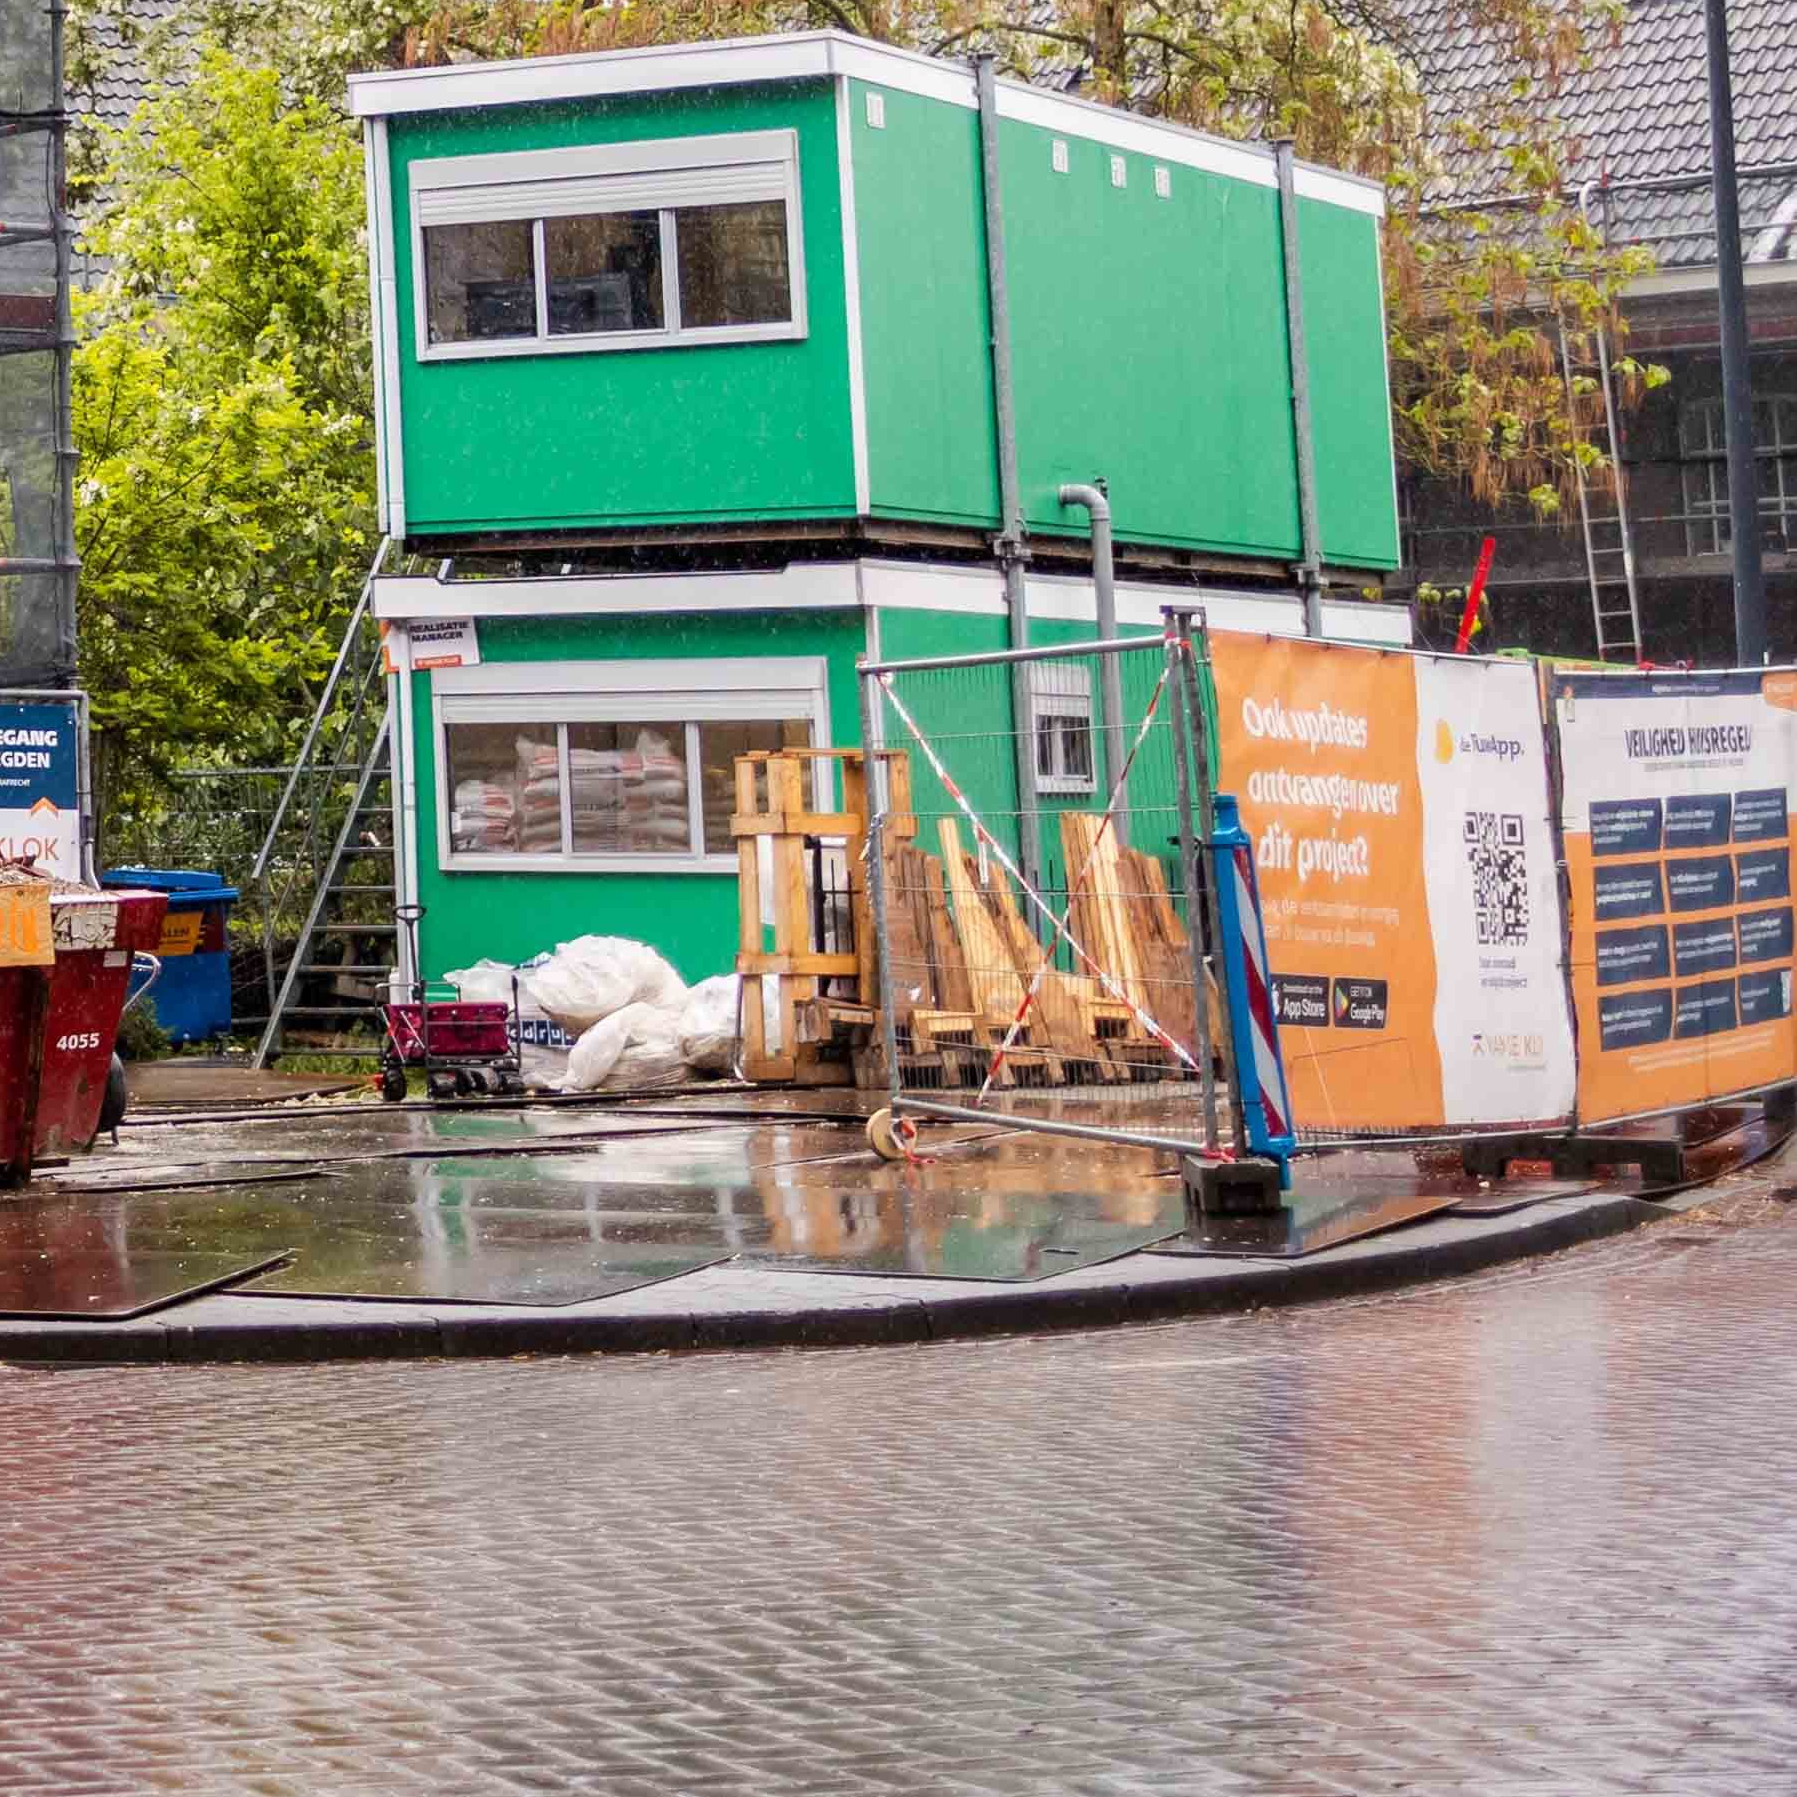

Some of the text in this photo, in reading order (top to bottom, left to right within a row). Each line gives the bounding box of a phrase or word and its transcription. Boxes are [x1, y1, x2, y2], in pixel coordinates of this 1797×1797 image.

[409, 621, 470, 633] REALISATIE
[411, 630, 463, 642] MANAGER
[1242, 698, 1367, 755] Ook updates
[57, 1032, 100, 1051] 4055
